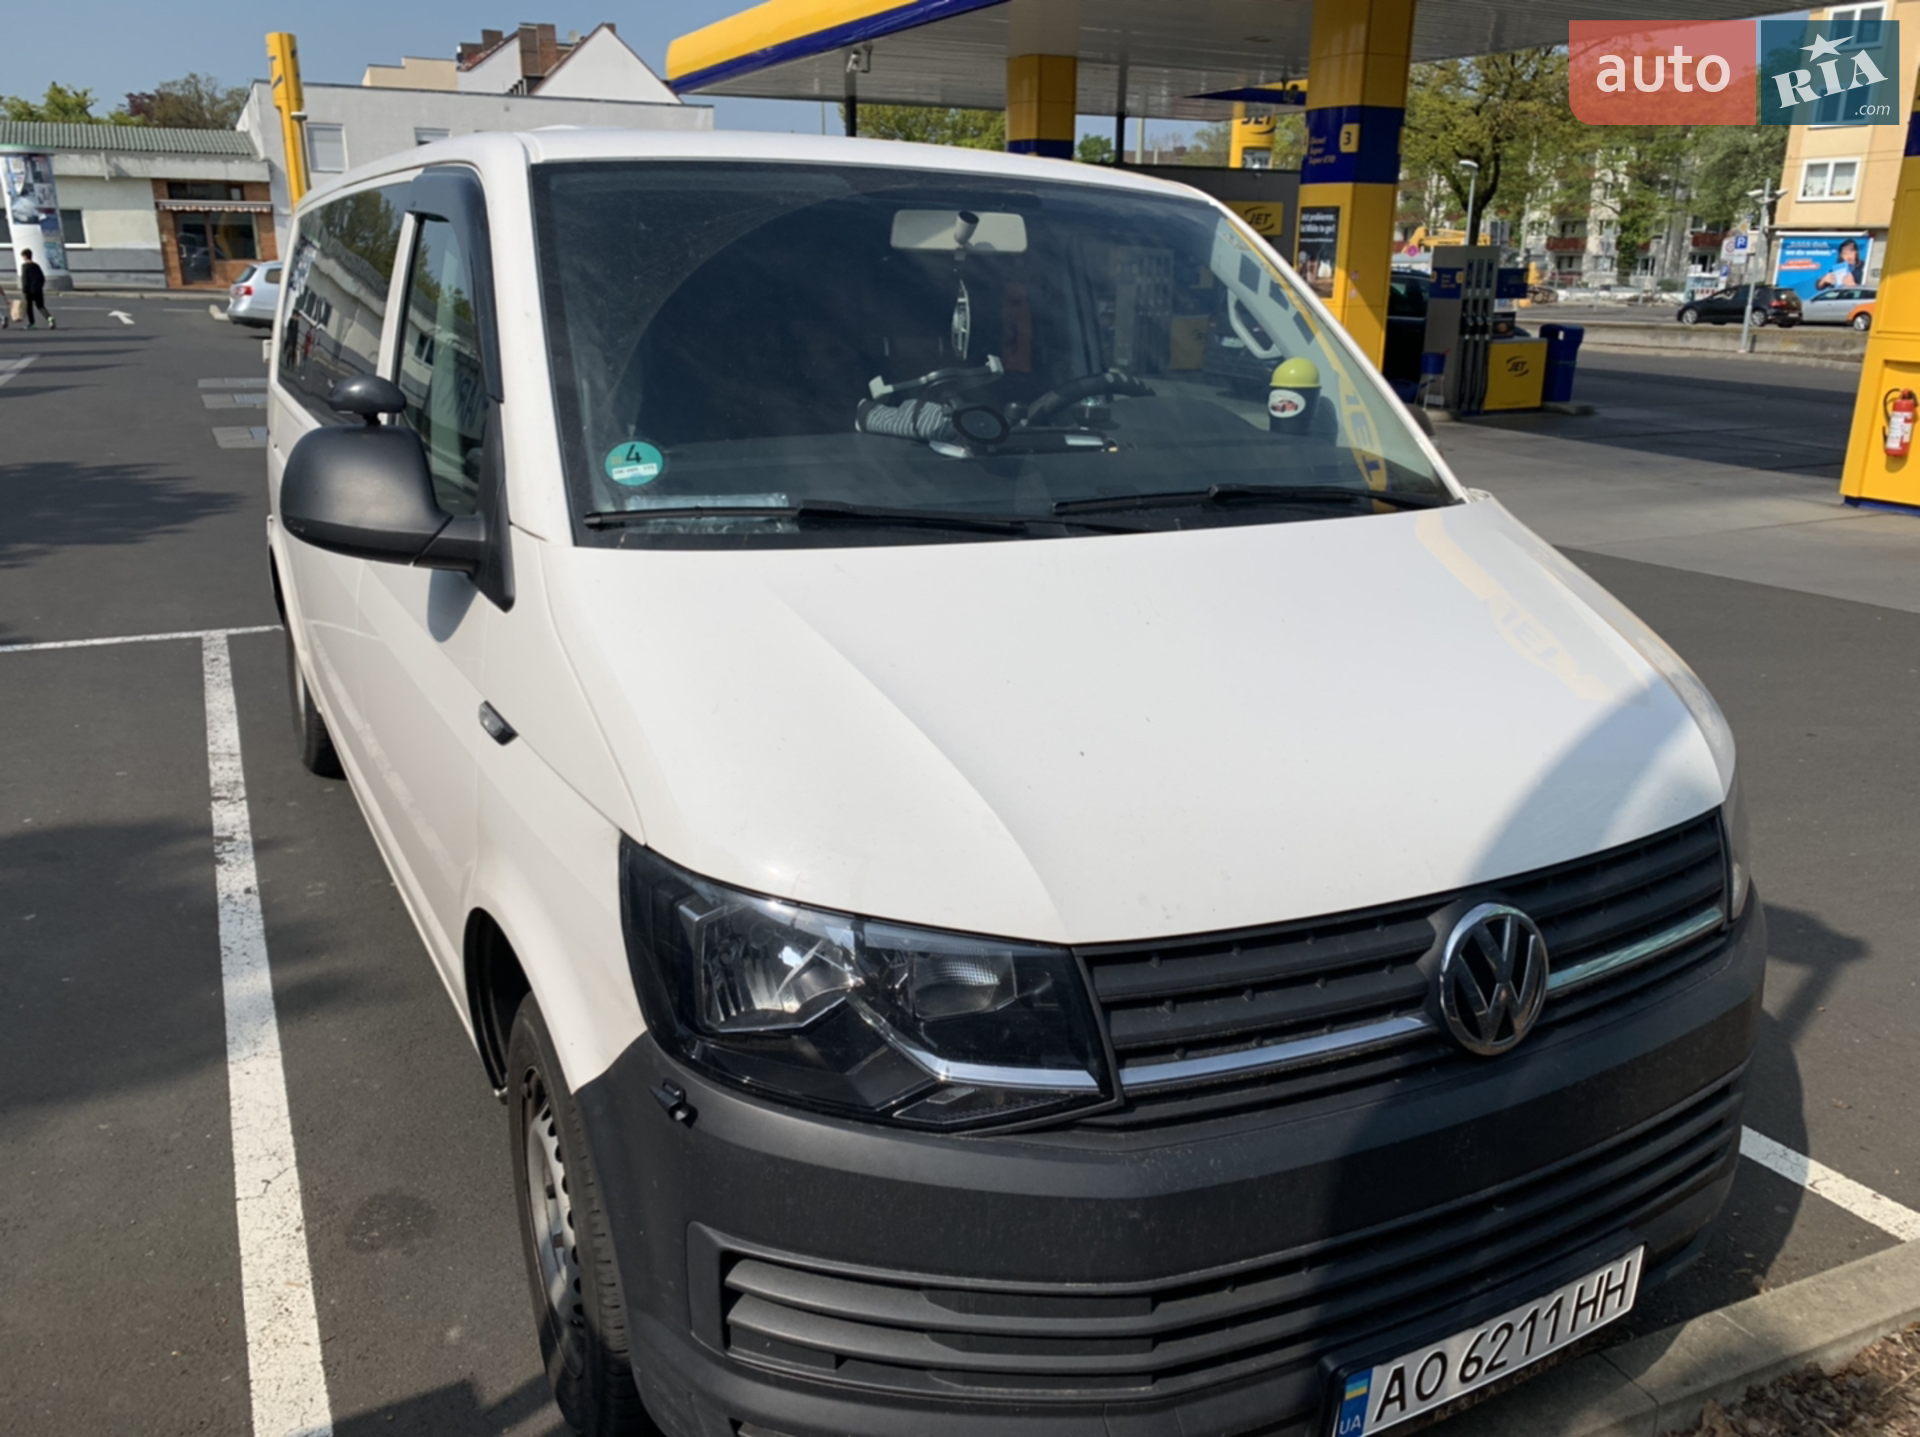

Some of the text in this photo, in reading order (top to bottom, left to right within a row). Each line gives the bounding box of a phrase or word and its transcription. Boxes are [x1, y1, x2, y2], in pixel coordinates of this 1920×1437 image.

[1343, 131, 1352, 146] 3
[1249, 213, 1271, 226] JET
[1508, 361, 1528, 372] JET
[625, 444, 642, 463] 4
[1372, 1258, 1631, 1423] AO 6211 HH
[1339, 1414, 1361, 1435] UA
